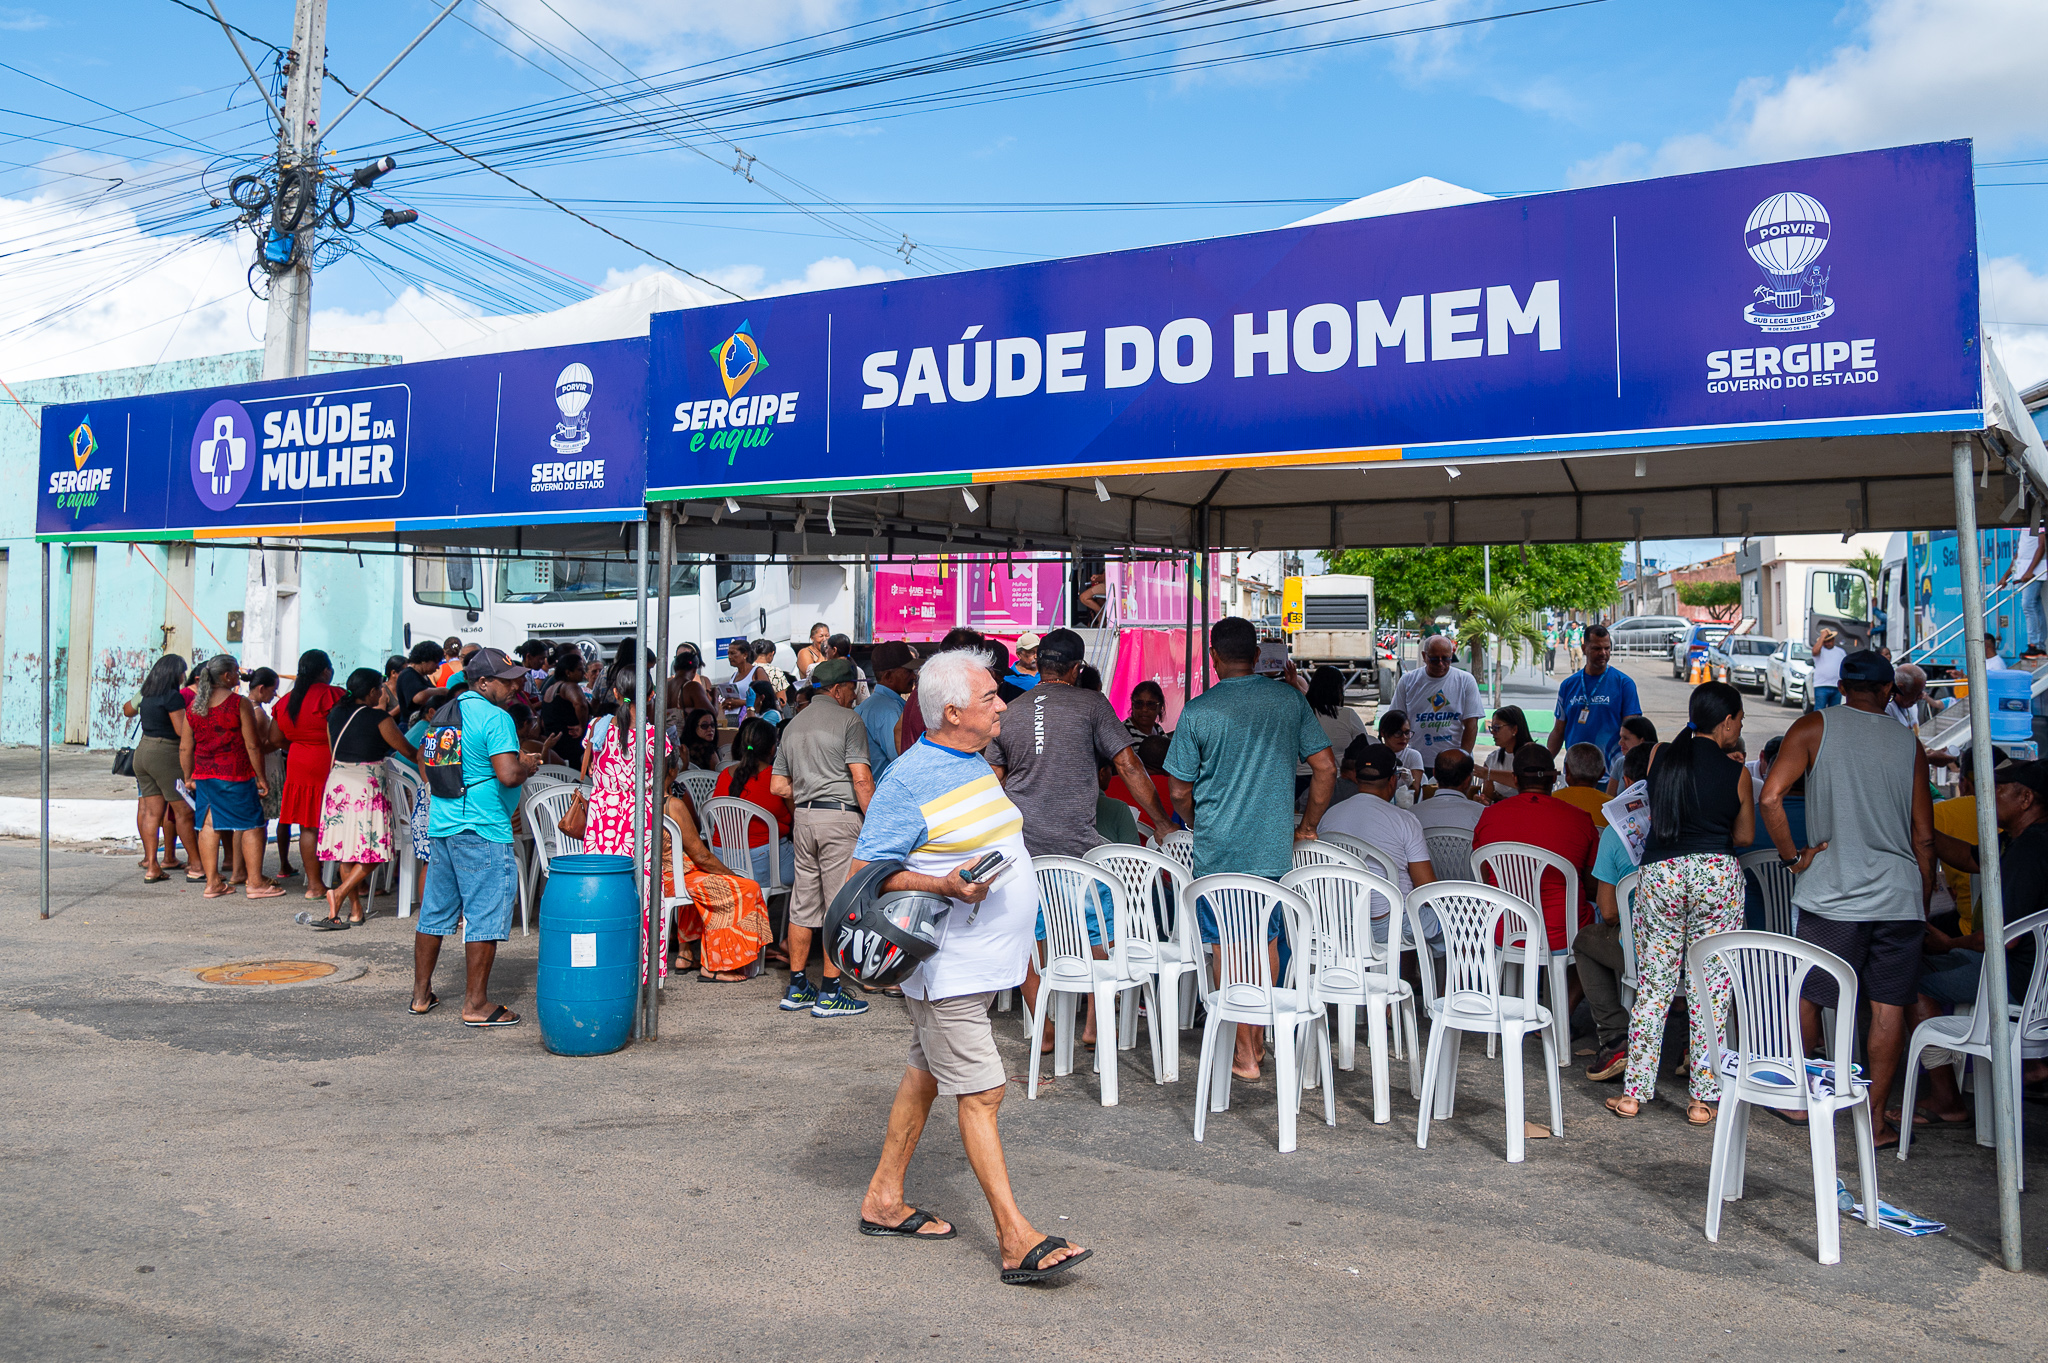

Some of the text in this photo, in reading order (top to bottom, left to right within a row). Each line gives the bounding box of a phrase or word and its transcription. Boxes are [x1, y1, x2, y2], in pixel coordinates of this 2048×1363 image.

[1759, 223, 1815, 240] PORVIR
[1753, 316, 1768, 324] SUB
[1790, 311, 1826, 323] LIBERTAS
[862, 279, 1562, 410] SAÚDE DO HOMEM
[1706, 338, 1877, 380] SERGIPE
[561, 383, 587, 393] PORVIR
[1707, 370, 1879, 394] GOVERNO DO ESTADO
[262, 396, 396, 449] SAÚDE DA
[672, 391, 800, 433] SERGIPE
[709, 415, 774, 466] aqui
[48, 467, 113, 494] SERGIPE
[261, 444, 394, 491] MULHER
[531, 459, 605, 483] SERGIPE
[530, 479, 605, 492] GOVERNO DO ESTADO
[66, 484, 99, 520] aqui
[1415, 711, 1461, 722] SERGIPE
